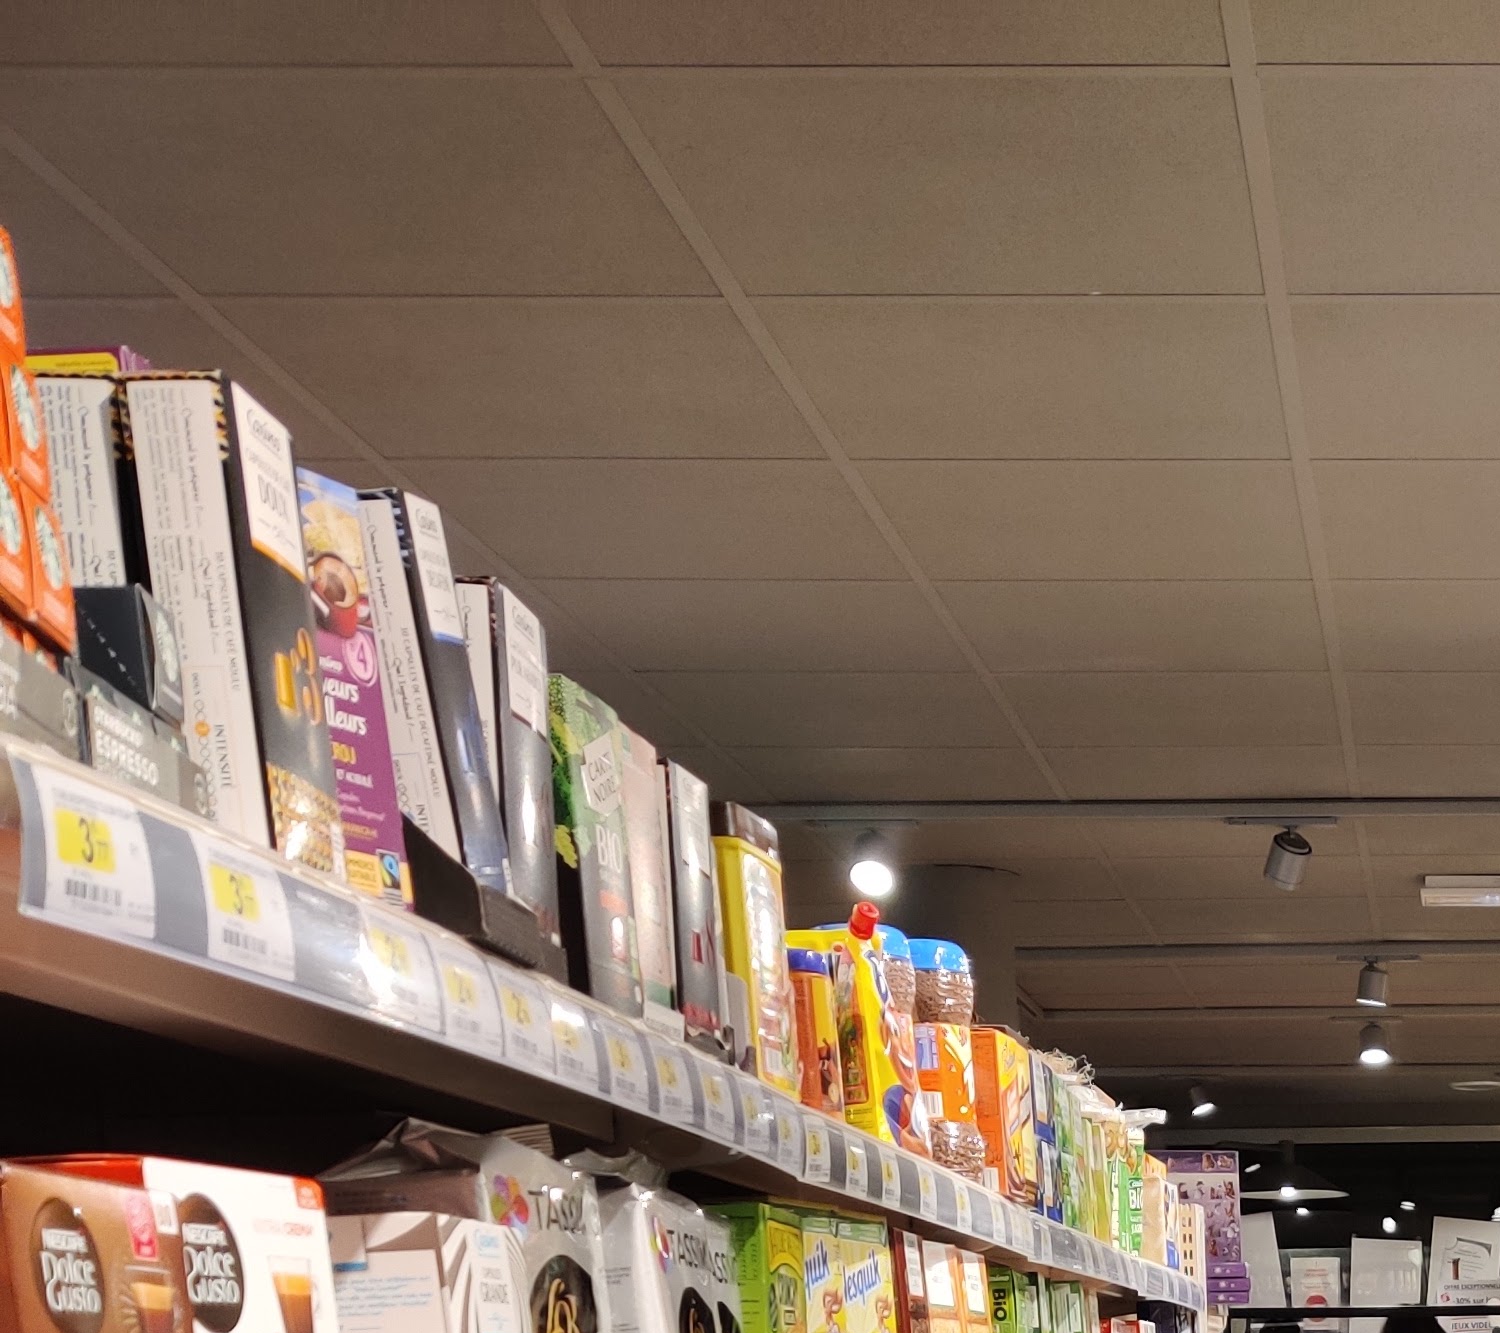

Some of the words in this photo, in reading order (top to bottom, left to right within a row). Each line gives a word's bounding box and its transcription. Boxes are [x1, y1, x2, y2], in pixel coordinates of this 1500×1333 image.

[597, 824, 623, 874] BIO
[40, 1250, 95, 1284] Dolce
[183, 1245, 236, 1279] Dolce
[45, 1282, 101, 1313] Gusto
[186, 1276, 241, 1304] Gusto
[1451, 1322, 1470, 1331] JEUX
